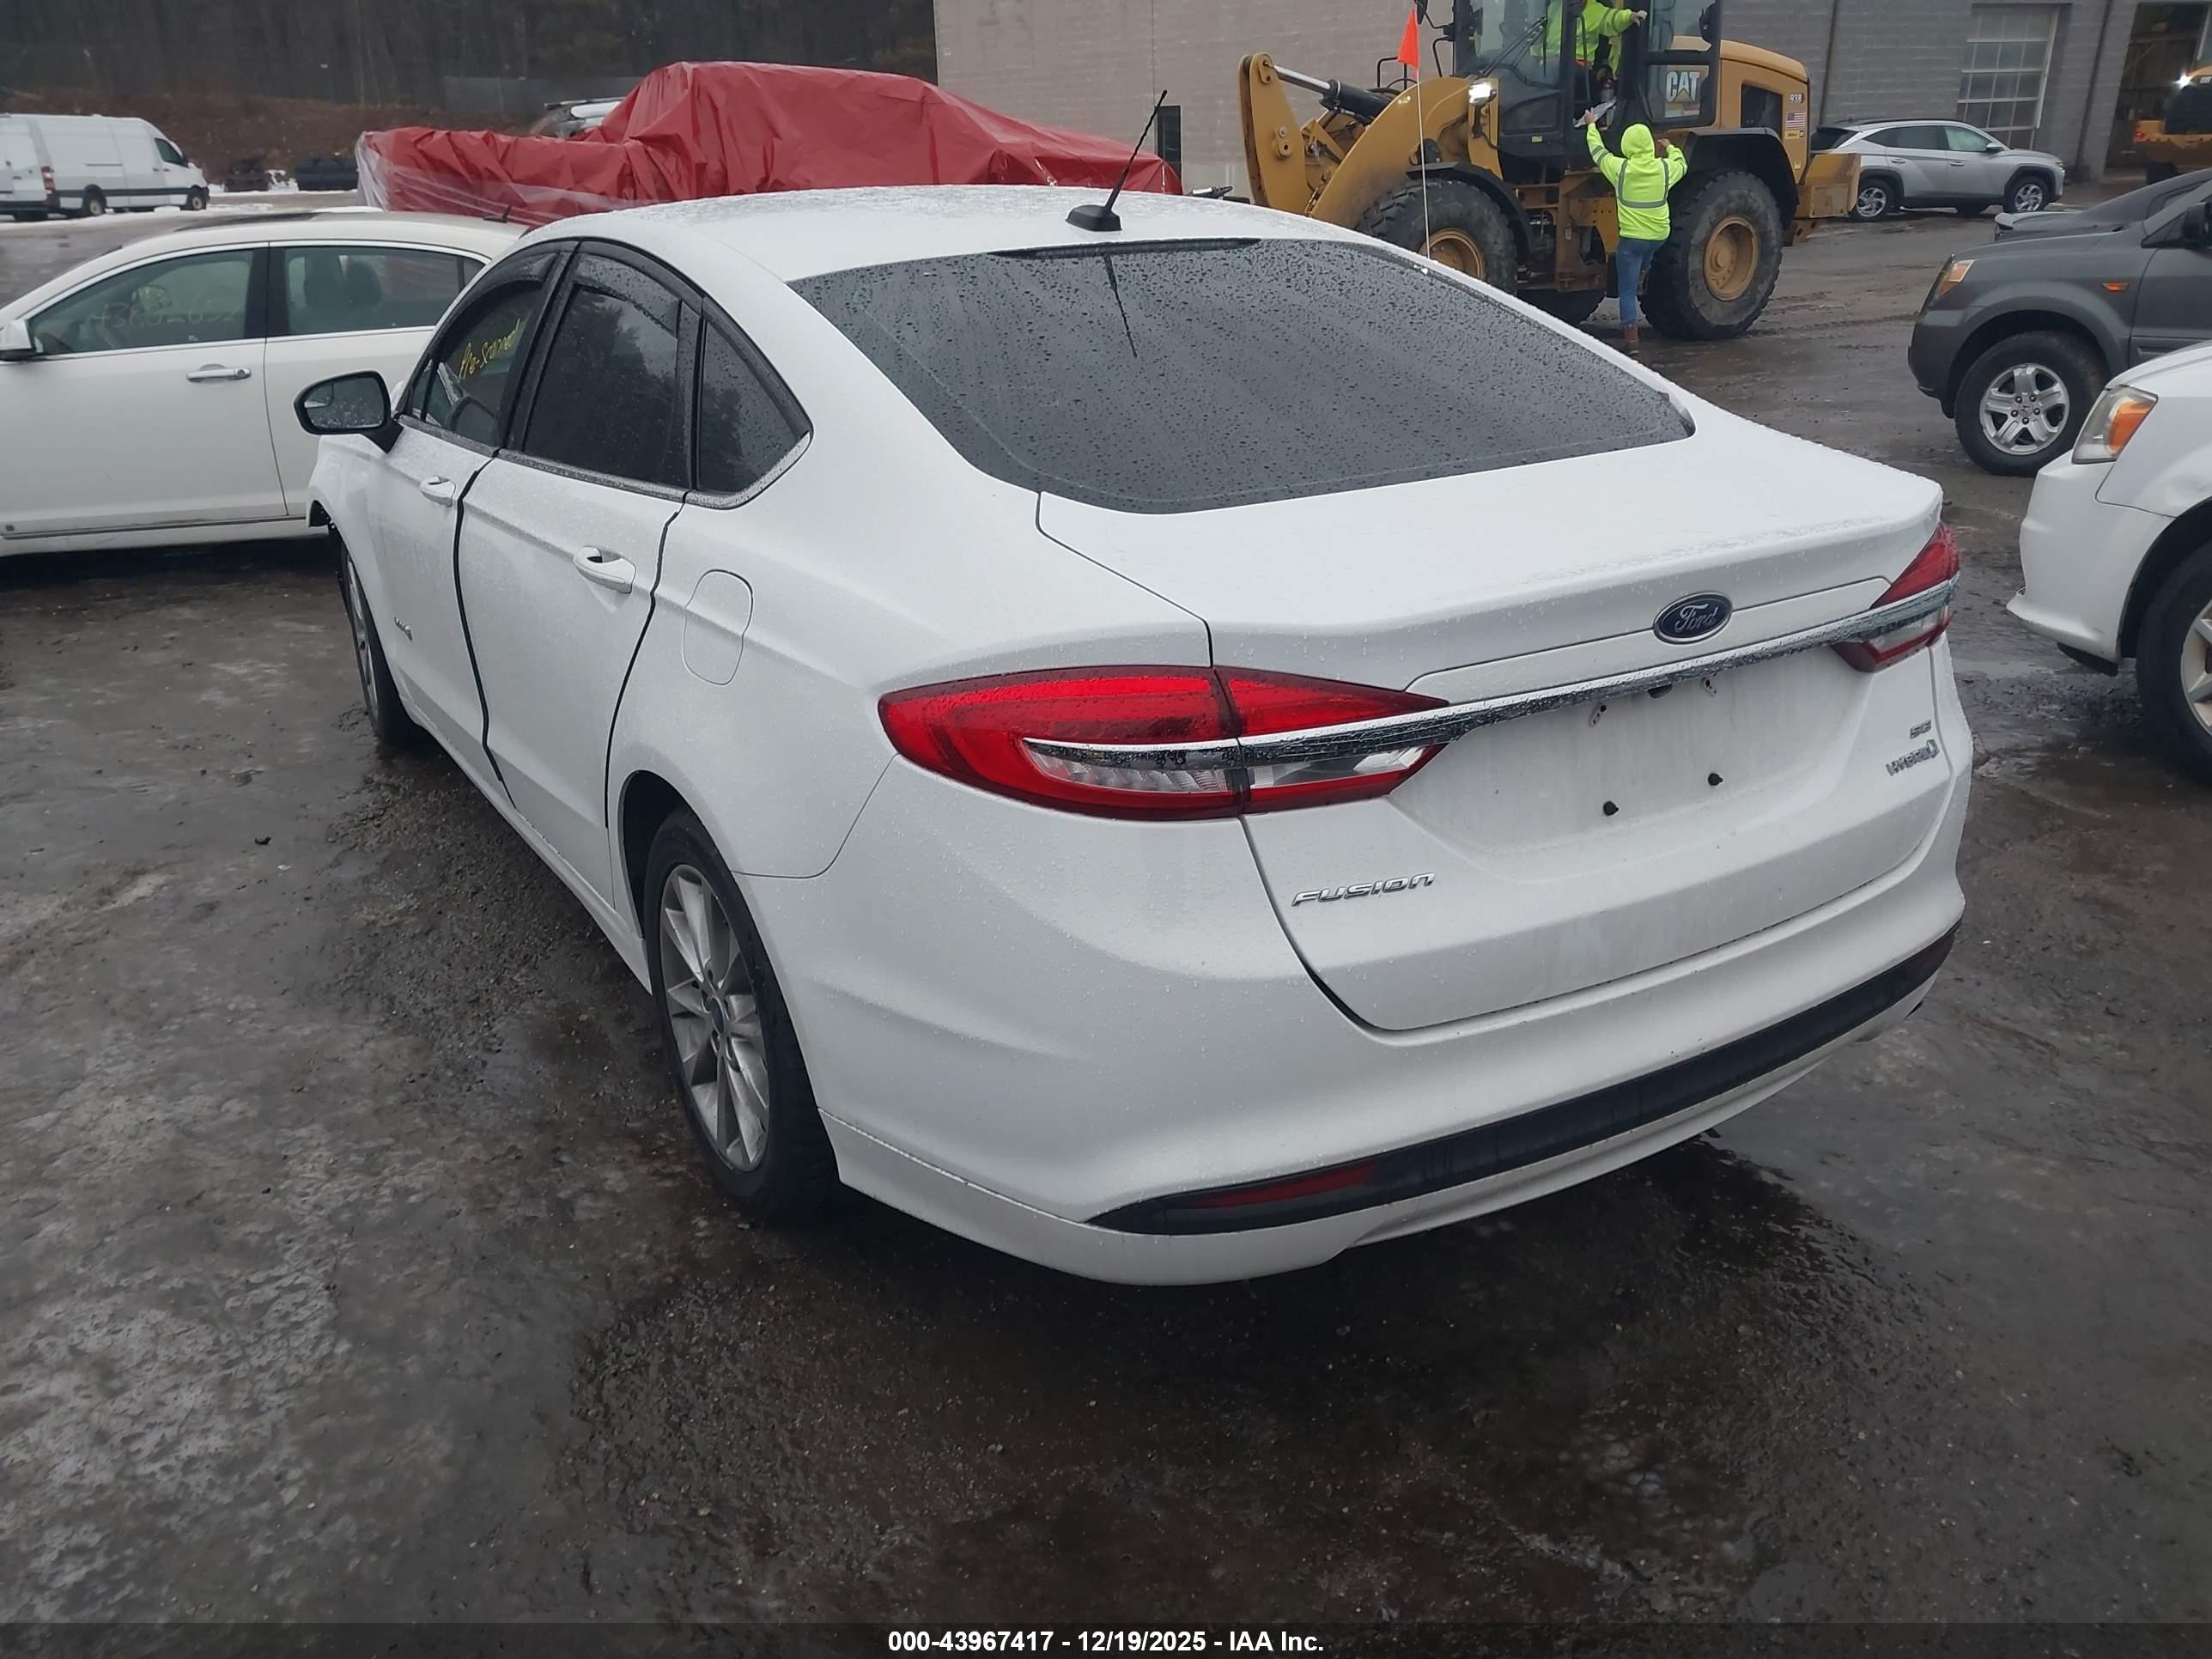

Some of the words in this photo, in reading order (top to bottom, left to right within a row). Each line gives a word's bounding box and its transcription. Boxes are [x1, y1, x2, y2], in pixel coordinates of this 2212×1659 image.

[1666, 71, 1700, 102] CAT
[1674, 603, 1718, 633] Ford
[1291, 872, 1434, 907] FUSION
